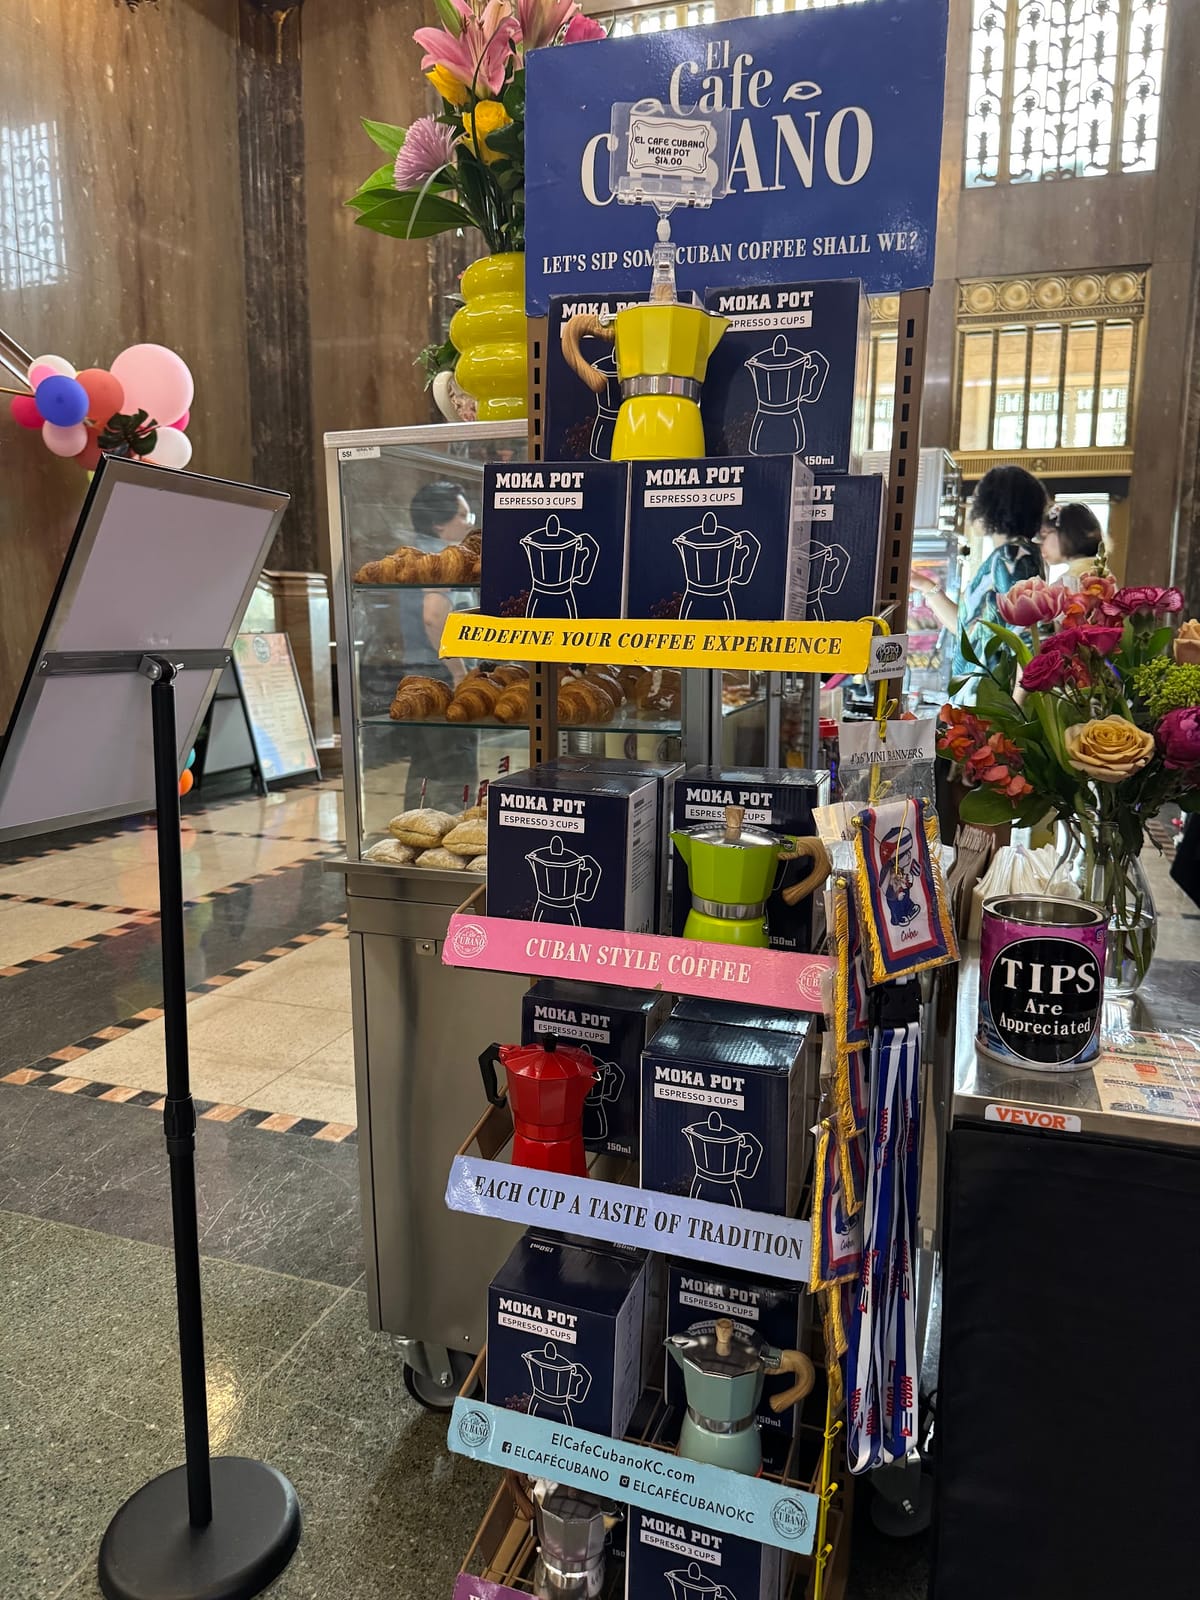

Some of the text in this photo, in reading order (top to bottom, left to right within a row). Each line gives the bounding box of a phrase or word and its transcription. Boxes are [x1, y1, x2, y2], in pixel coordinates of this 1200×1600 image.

[707, 40, 729, 70] El
[670, 53, 773, 116] Cafe
[635, 136, 705, 149] EL CAFE CUBANO
[648, 147, 690, 157] MOKA POT
[581, 106, 873, 207] CANO
[655, 156, 682, 166] $14.00
[543, 231, 918, 274] LET'S SIP SOM CUBAN COFFEE SHALL WE?
[719, 290, 814, 312] MOKA POT
[773, 317, 778, 326] 3
[780, 316, 805, 325] CUPS
[495, 472, 584, 489] MOKA POT
[645, 466, 745, 486] MOKA POT
[499, 497, 577, 506] ESPRESSO 3 CUPS
[650, 493, 736, 504] ESPRESSO 3 CUPS
[811, 484, 835, 501] OT
[458, 625, 842, 655] REDEFINE YOUR COFFEE EXPERIENCE
[867, 751, 885, 763] MINI
[887, 747, 924, 761] BANNERS
[500, 793, 585, 815] MOKA POT
[686, 788, 773, 807] MOKA POT
[504, 815, 579, 830] ESPRESSO 3 CUPS
[769, 936, 797, 947] 150ml
[525, 937, 752, 984] CUBAN STYLE COFFEE
[1000, 957, 1096, 995] TIPS
[534, 1005, 611, 1028] MOKA POT
[1024, 998, 1063, 1016] Are
[538, 1023, 577, 1036] ESPRESSO
[584, 1031, 605, 1041] CUPS
[999, 1012, 1091, 1036] Appreciated
[655, 1066, 745, 1092] MOKA POT
[659, 1087, 738, 1107] ESPRESSO 3 CUPS
[995, 1106, 1066, 1130] VEVOR
[607, 1142, 632, 1155] 150ml
[475, 1175, 803, 1260] EACH CUP A TASTE OF TRADITION
[680, 1277, 760, 1305] MOKA POT
[499, 1297, 578, 1328] MOKA POT
[683, 1295, 754, 1318] ESPRESSO 3 CUPS
[502, 1317, 572, 1341] ESPRESSO 3 CUPS
[551, 1433, 695, 1484] ElCafeCubanoKC.com
[514, 1445, 755, 1524] ELCAFÉCUBANO ELCAFÉCUBANOKC
[641, 1515, 722, 1550] MOKA POT
[644, 1534, 687, 1553] ESPRESSO
[694, 1549, 716, 1562] CUPS
